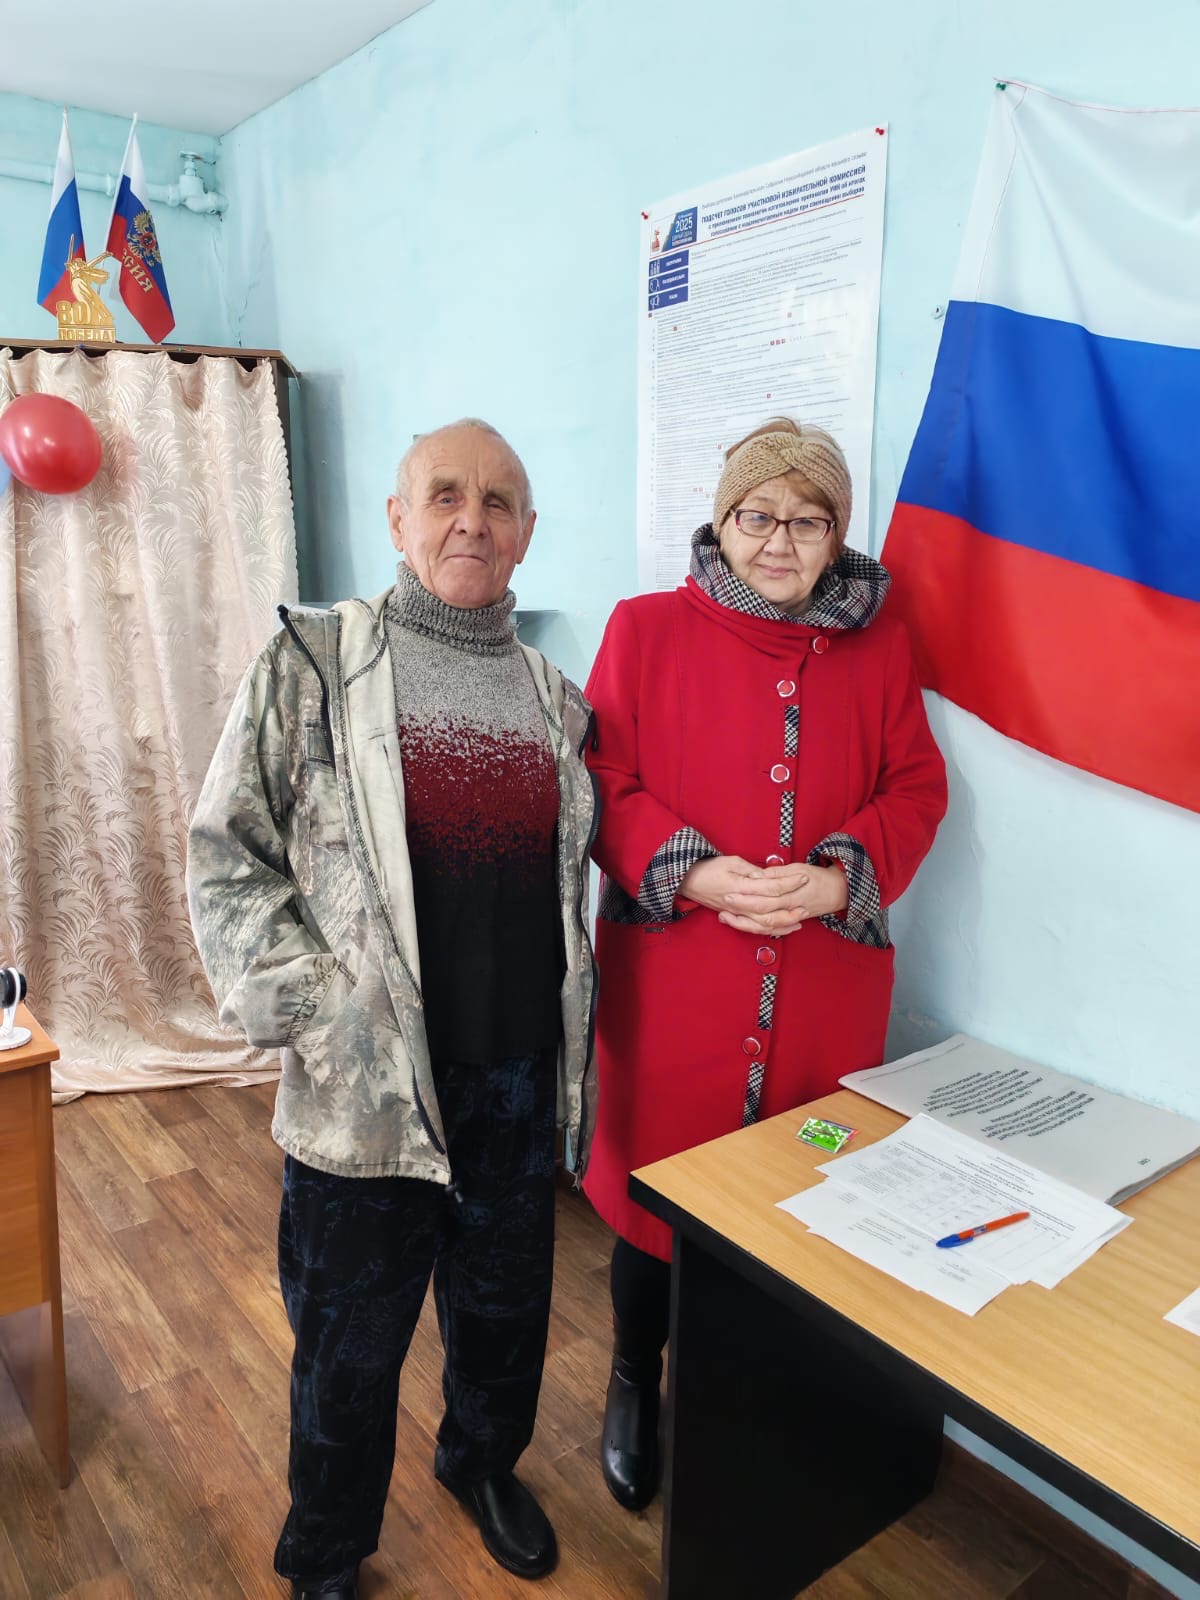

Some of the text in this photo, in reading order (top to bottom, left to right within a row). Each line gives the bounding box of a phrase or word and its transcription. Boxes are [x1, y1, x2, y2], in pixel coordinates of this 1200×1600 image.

[747, 192, 780, 209] УЧАСТКОВОЙ
[781, 176, 828, 199] ИЗБИРАТЕЛЬНОЙ
[829, 164, 866, 183] КОМИССИЕЙ
[675, 216, 693, 233] 2025
[56, 300, 91, 325] 80
